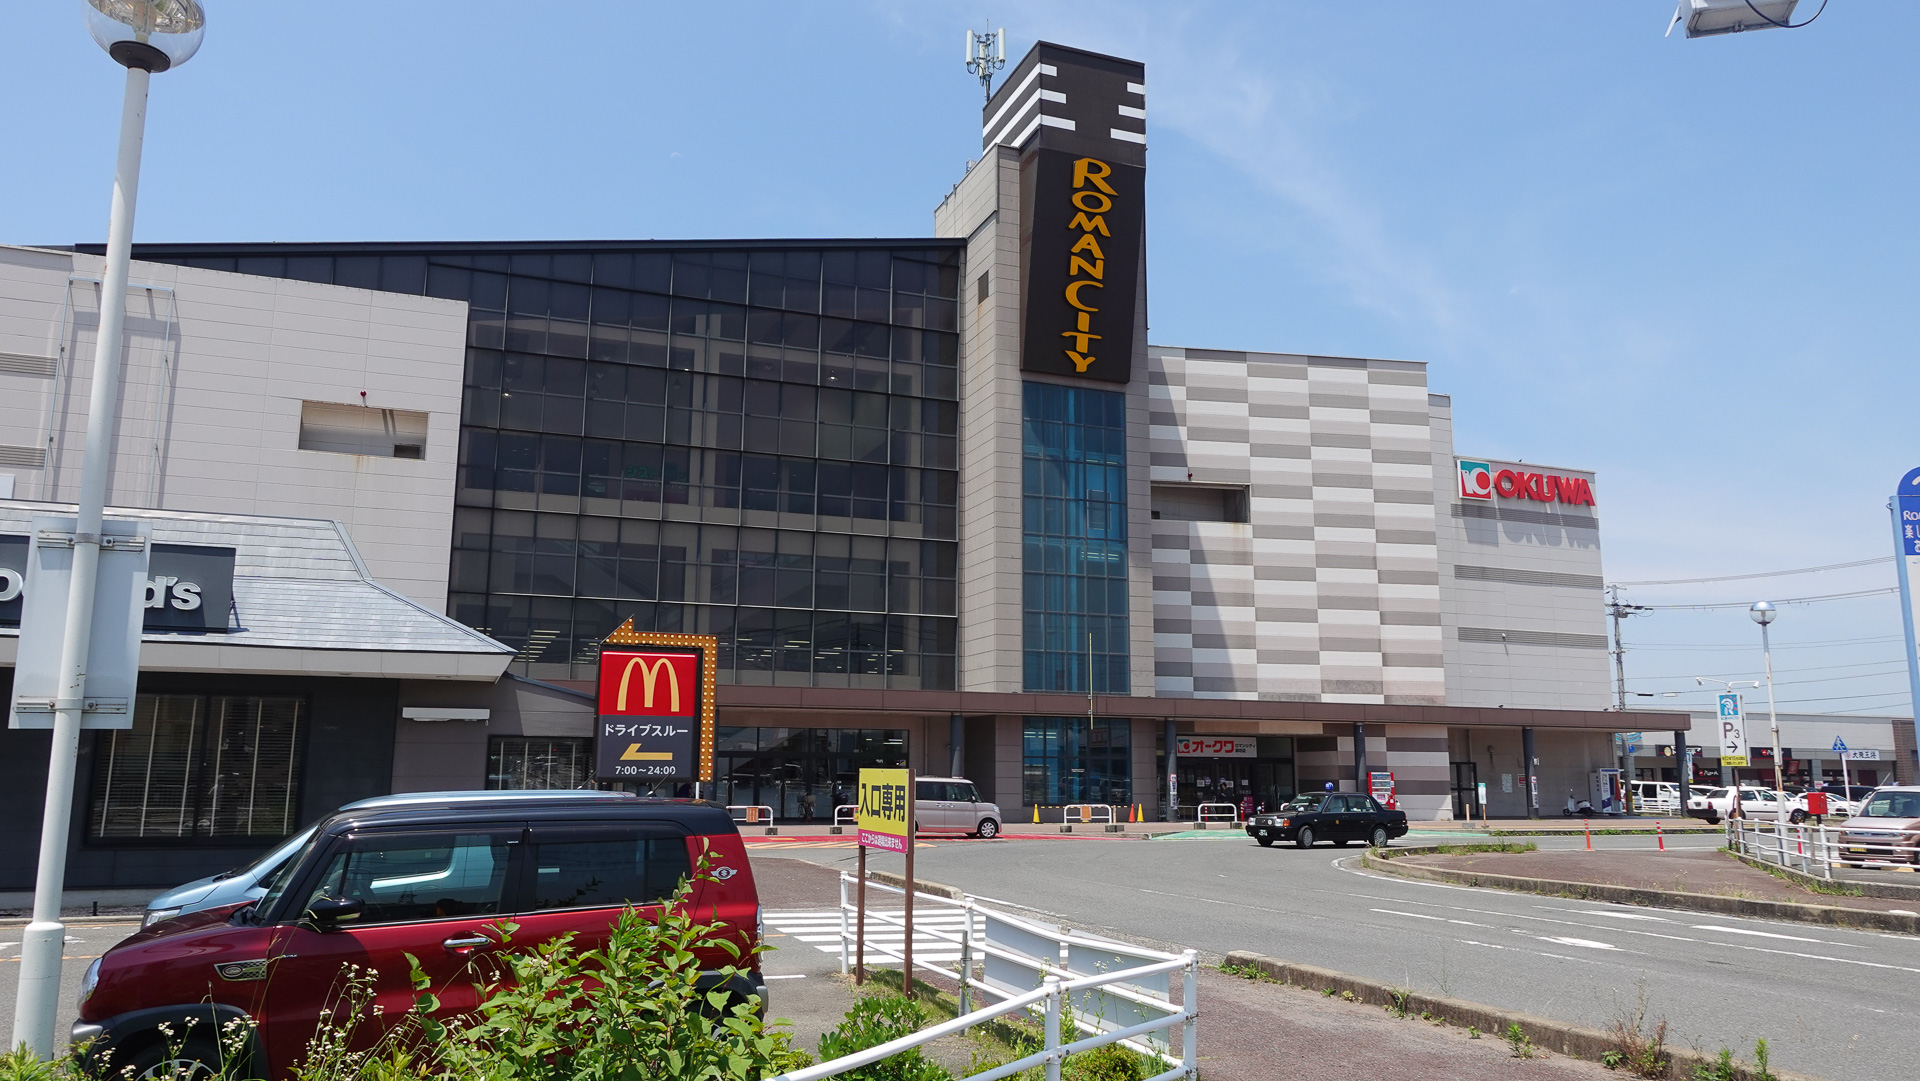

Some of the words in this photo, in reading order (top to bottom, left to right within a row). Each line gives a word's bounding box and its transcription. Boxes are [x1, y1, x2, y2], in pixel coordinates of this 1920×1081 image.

[1061, 157, 1119, 373] ROMANCITY
[1494, 469, 1596, 506] OKUWA
[605, 723, 689, 737] ドライブスルー
[1192, 740, 1234, 753] オークワ
[860, 783, 906, 822] 入口専用
